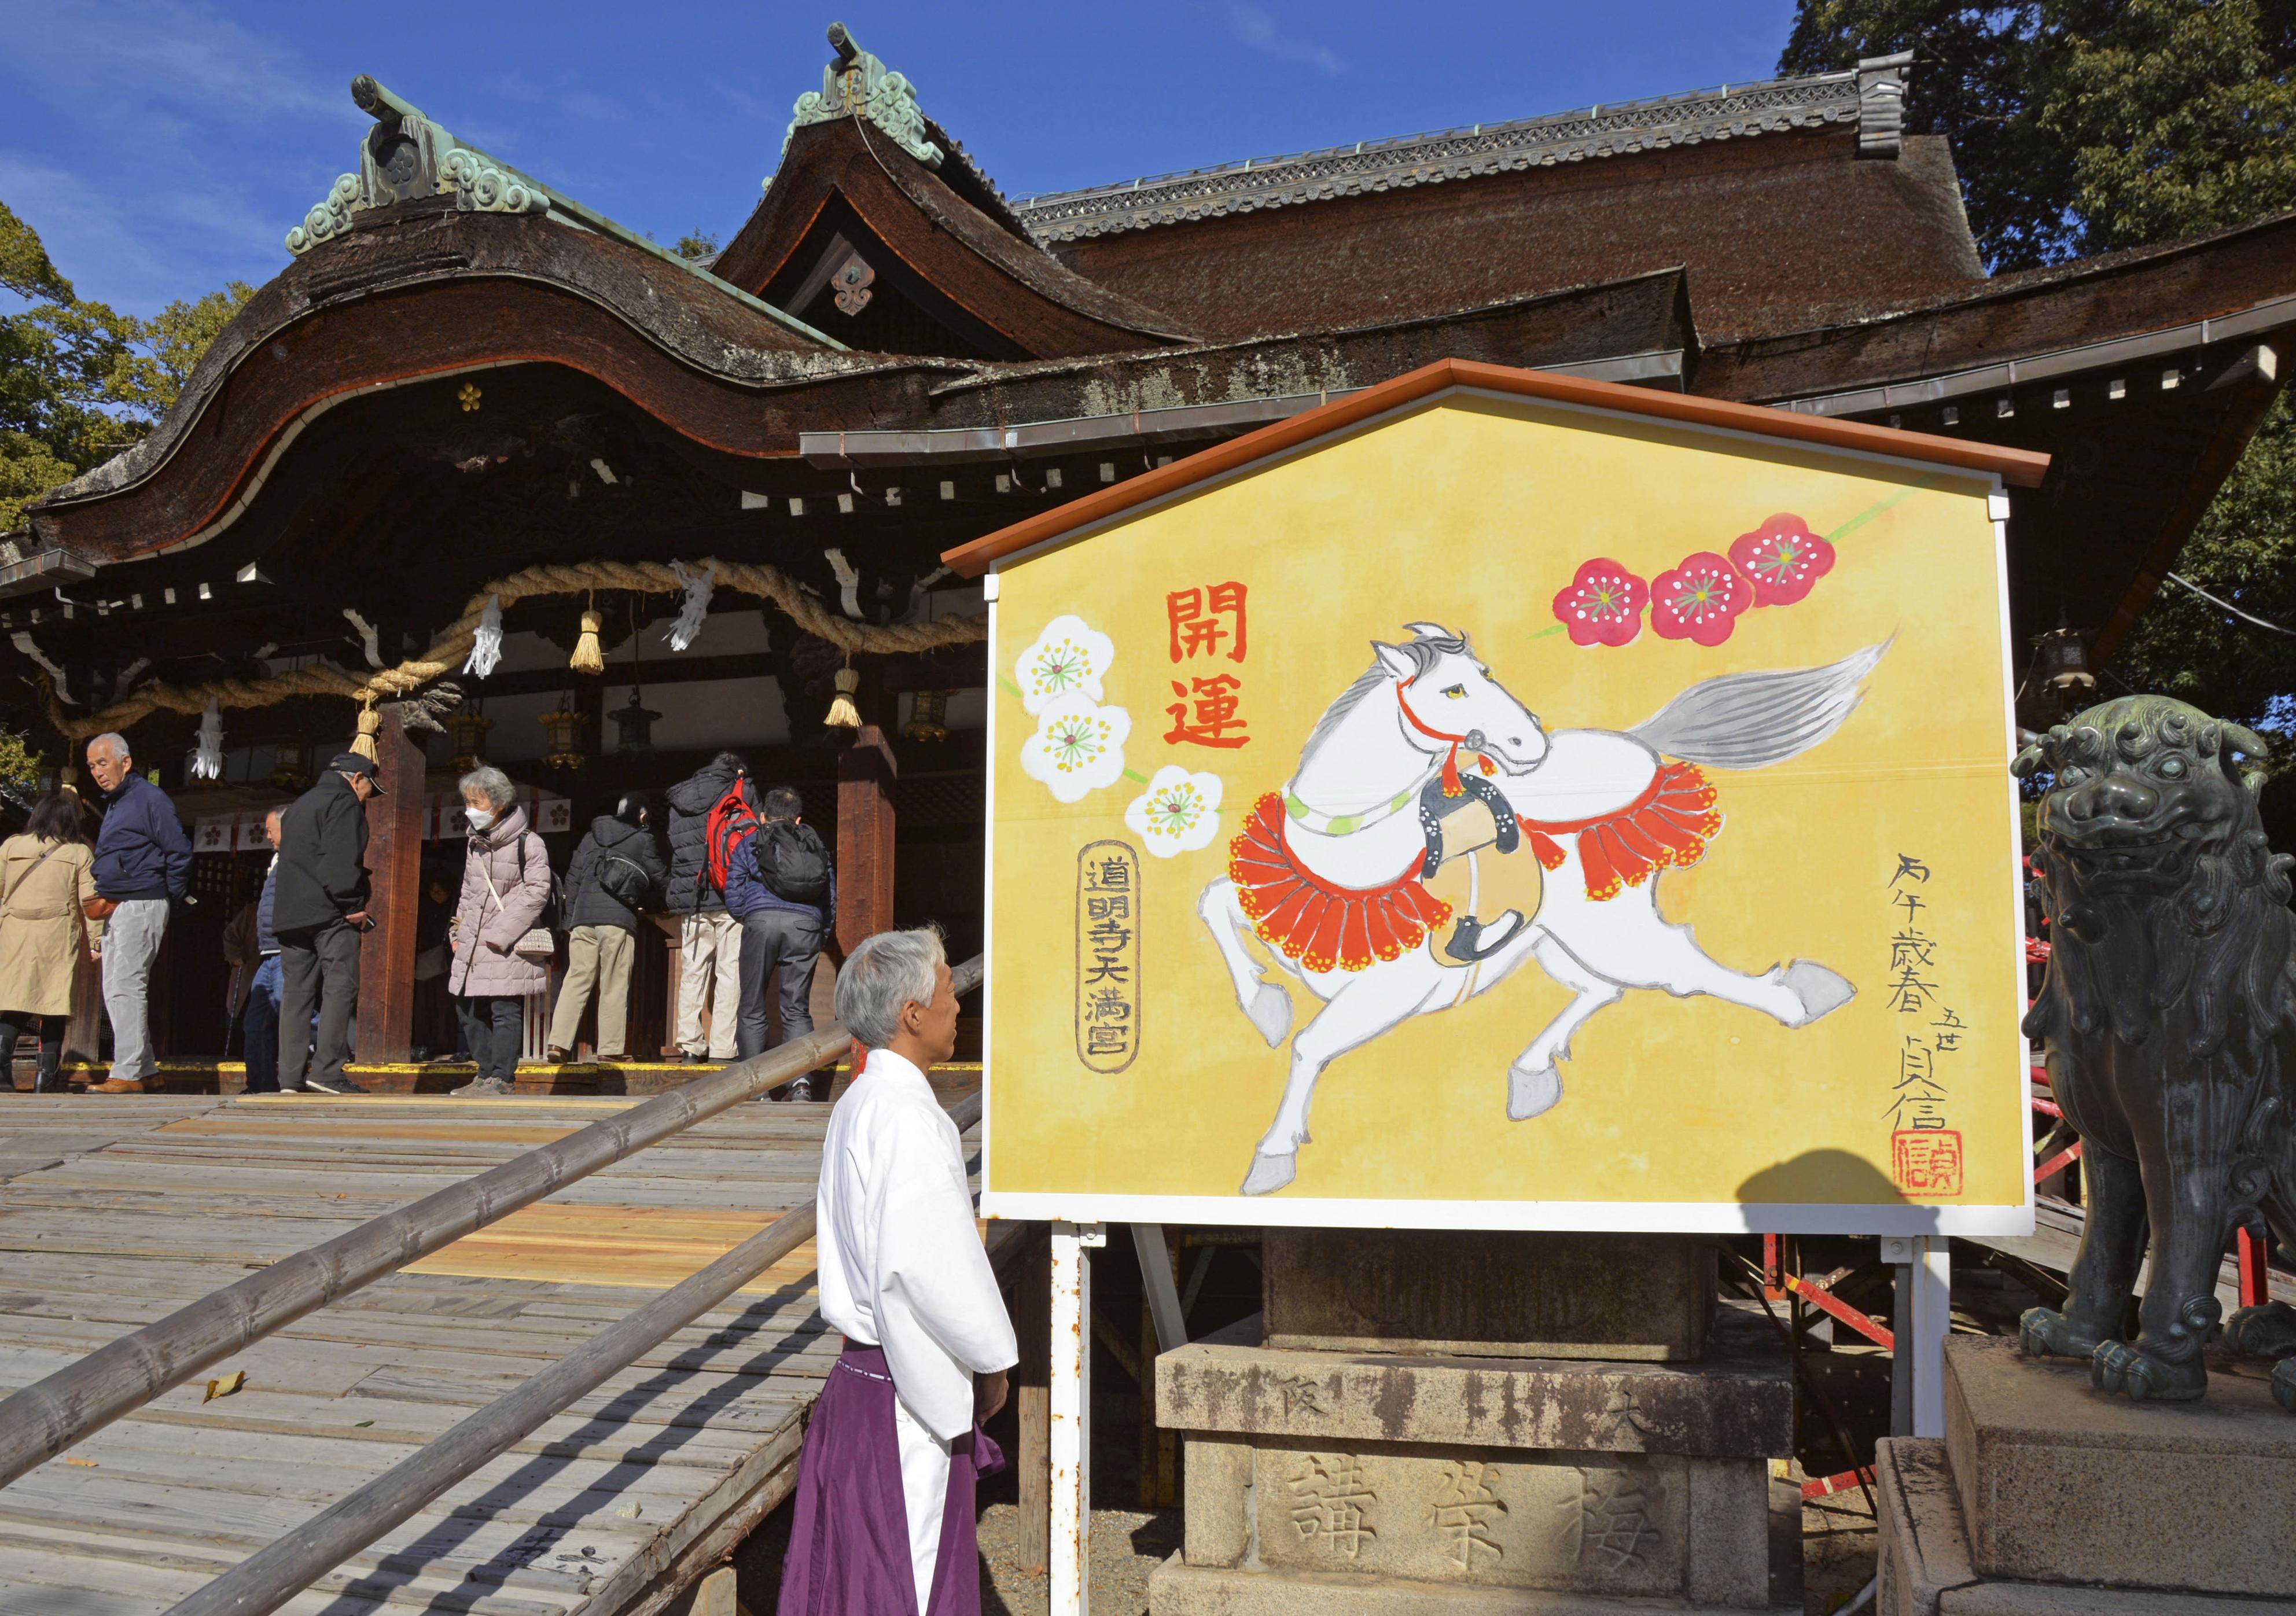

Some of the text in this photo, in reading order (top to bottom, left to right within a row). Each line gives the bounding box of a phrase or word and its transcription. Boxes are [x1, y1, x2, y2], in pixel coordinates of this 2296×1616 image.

[1163, 580, 1251, 749] 開運
[1084, 856, 1134, 1055] 道明寺天満宮
[1886, 853, 1940, 1013] 丙午歳春
